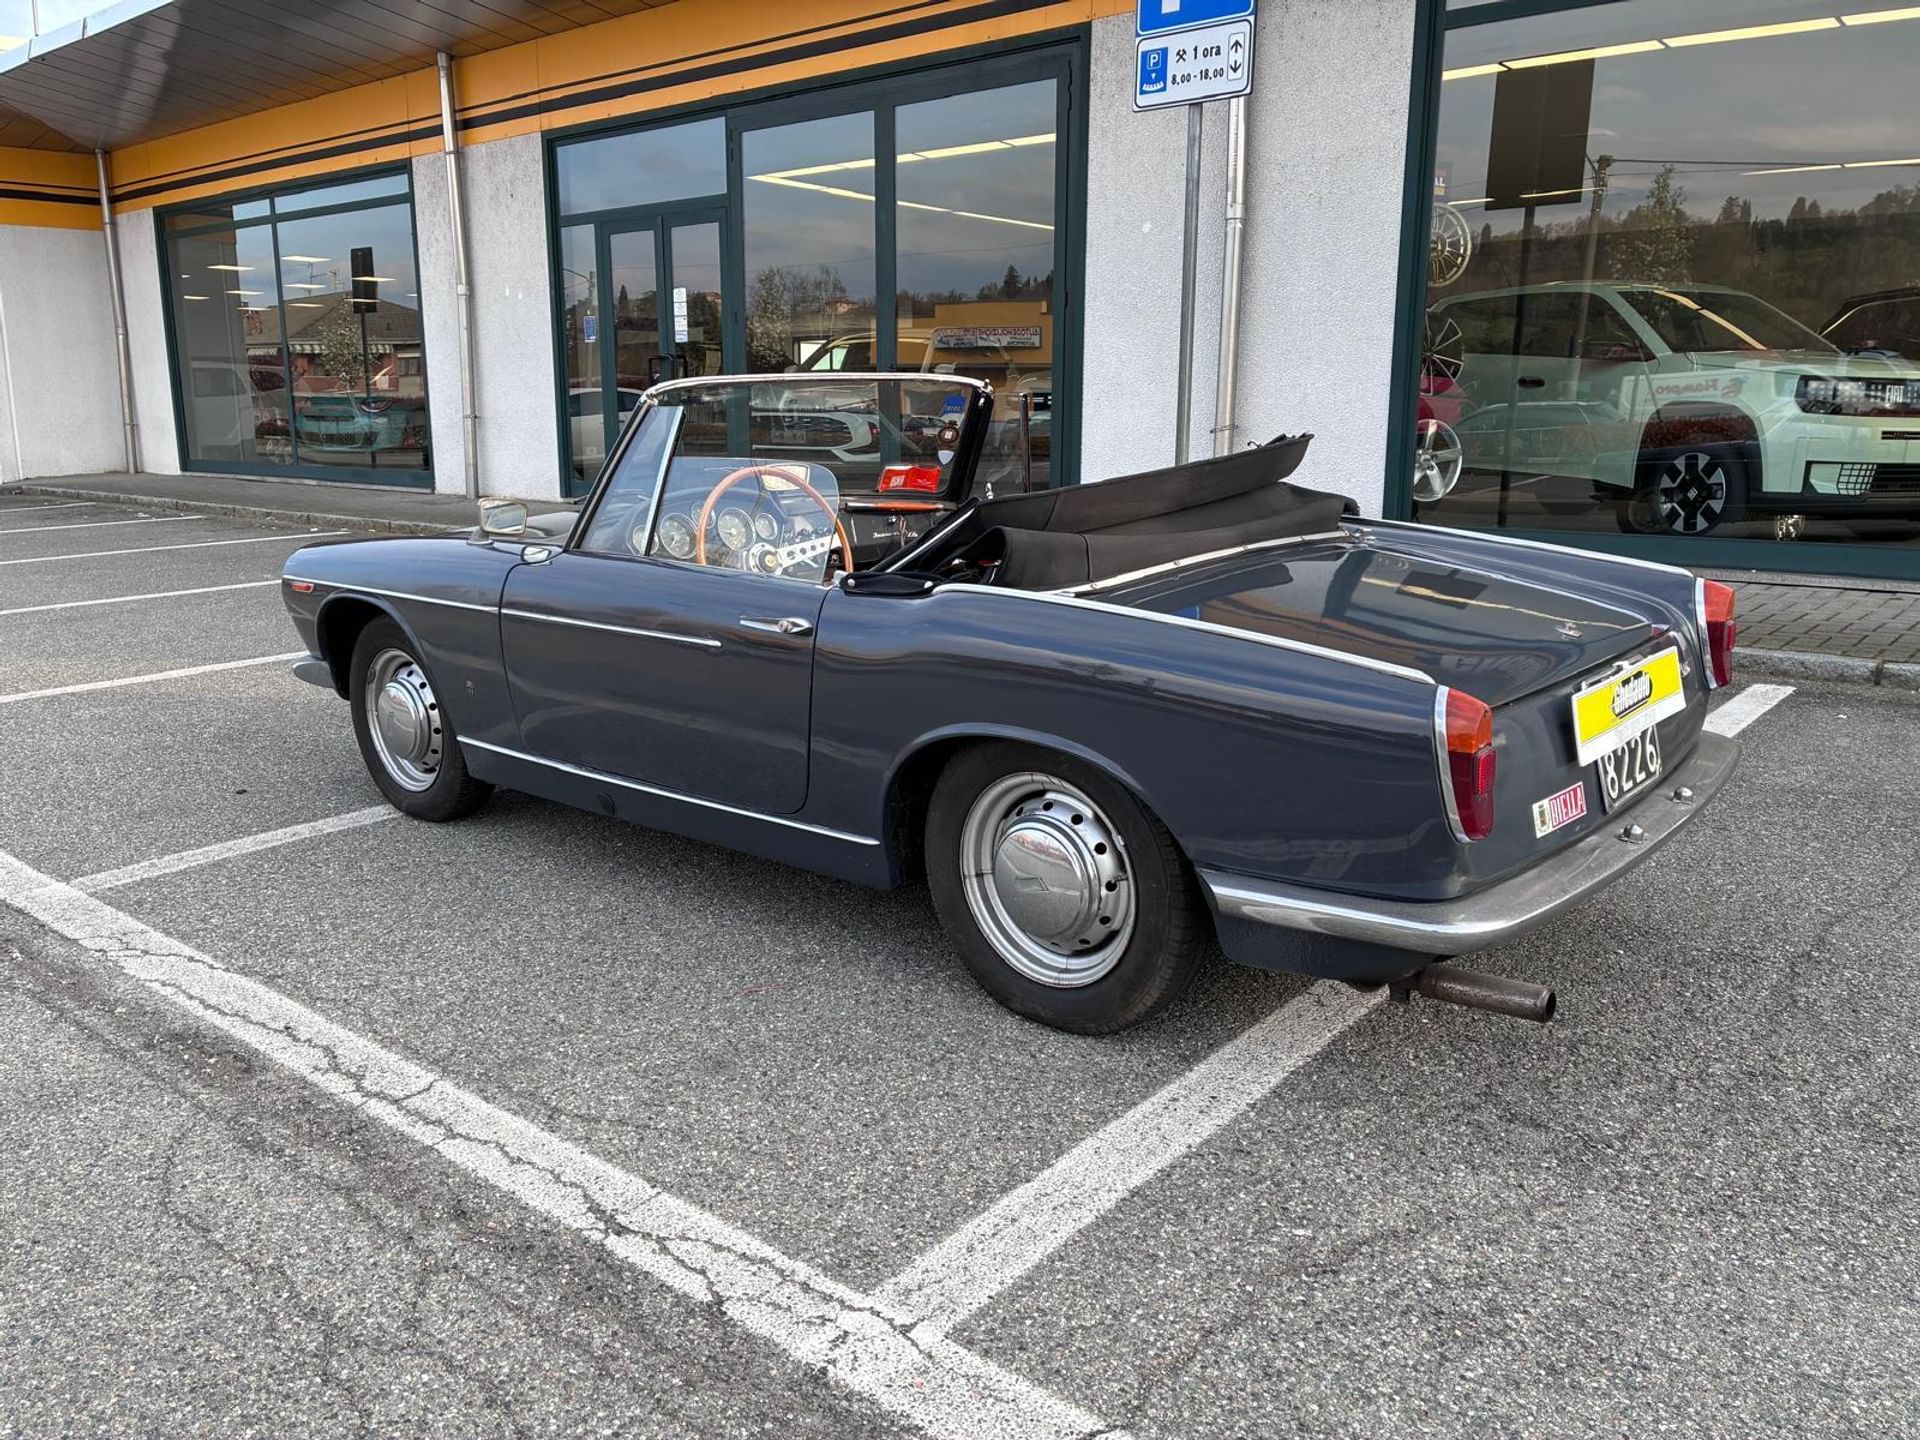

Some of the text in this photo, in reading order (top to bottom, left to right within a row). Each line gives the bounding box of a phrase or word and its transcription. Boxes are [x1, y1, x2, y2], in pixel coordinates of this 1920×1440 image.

[1193, 45, 1221, 60] 1 ora
[1885, 384, 1905, 403] FIAT
[1604, 725, 1657, 799] 8226
[1551, 787, 1585, 825] BIELLA
